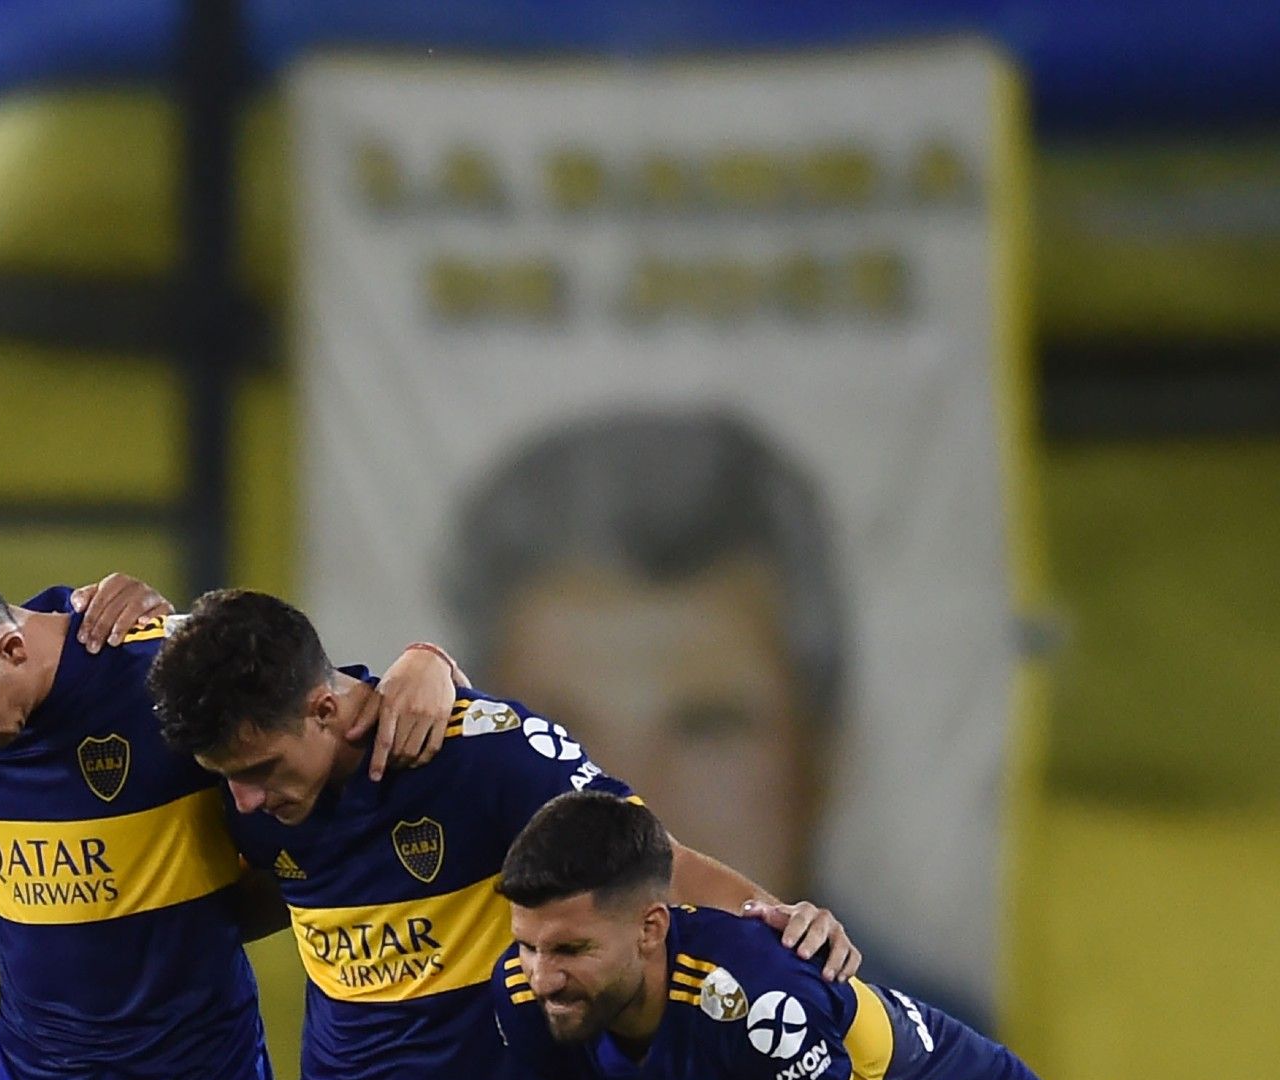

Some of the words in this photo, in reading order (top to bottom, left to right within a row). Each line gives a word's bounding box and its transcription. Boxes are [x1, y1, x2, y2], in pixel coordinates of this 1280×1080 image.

[13, 878, 119, 906] AIRWAYS
[303, 917, 441, 968] QATAR
[339, 954, 444, 988] AIRWAYS
